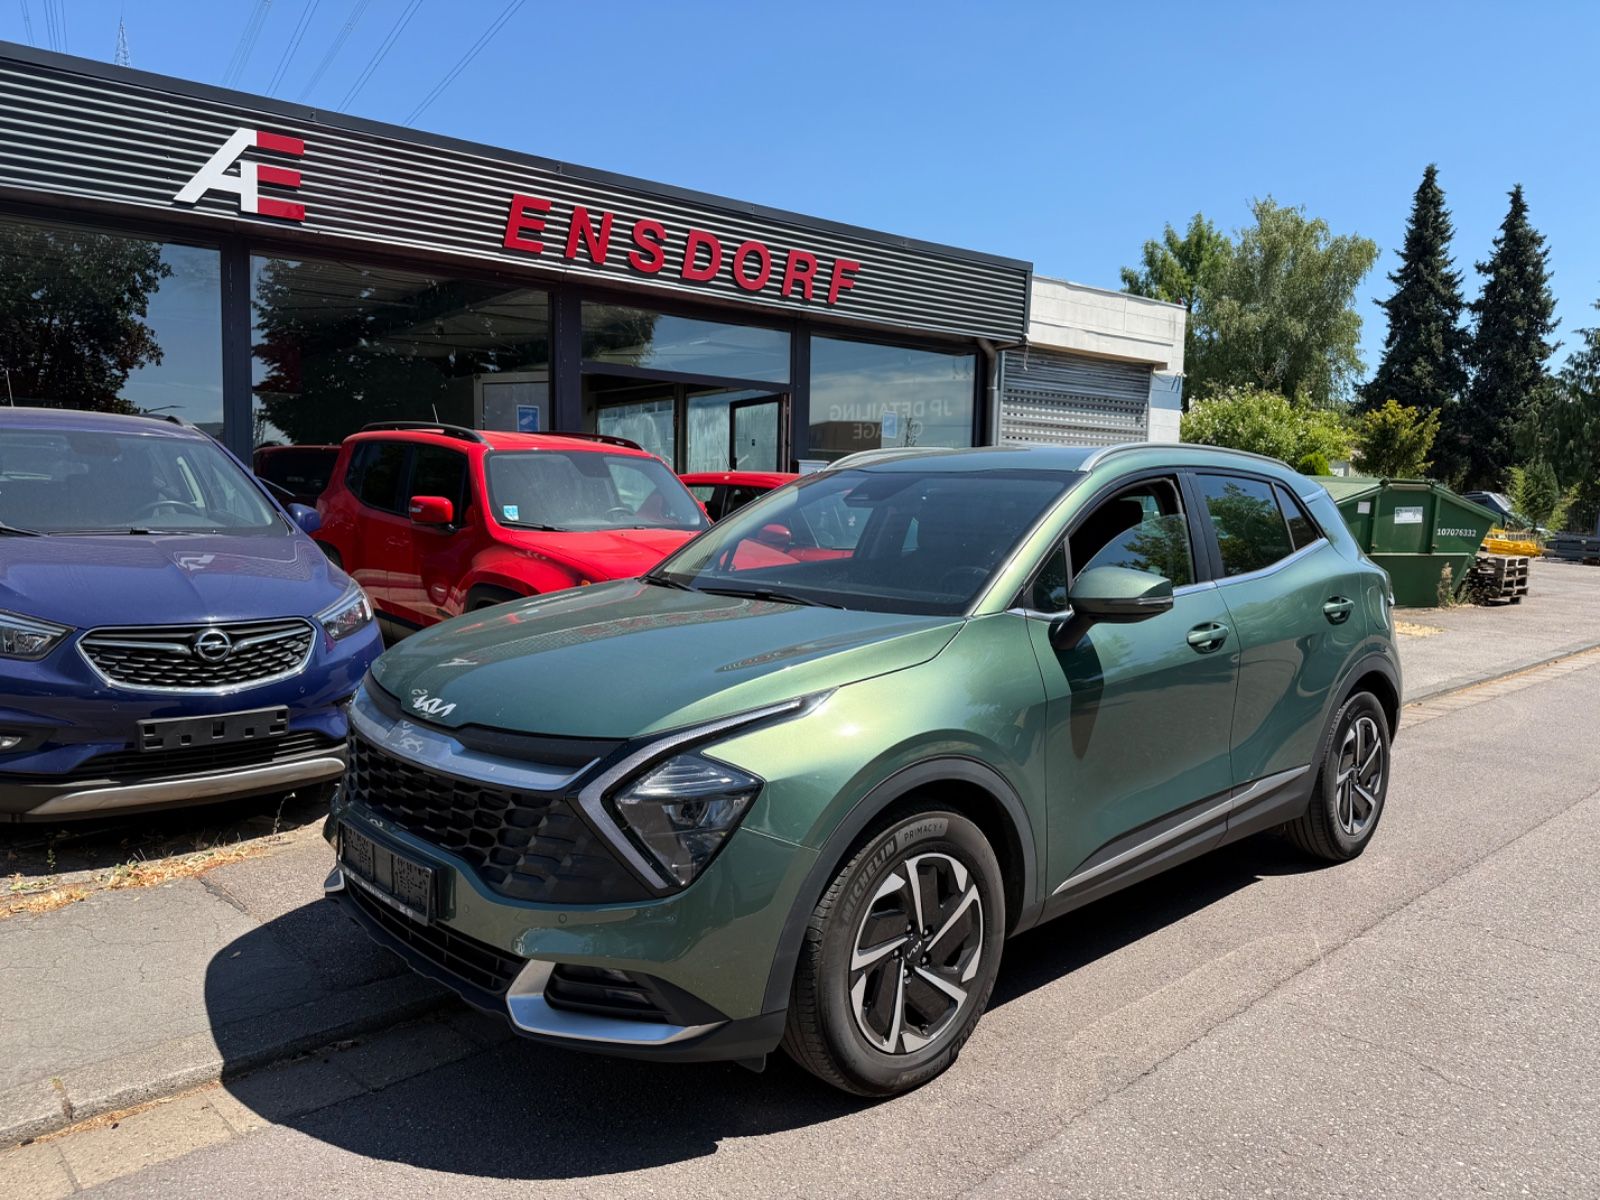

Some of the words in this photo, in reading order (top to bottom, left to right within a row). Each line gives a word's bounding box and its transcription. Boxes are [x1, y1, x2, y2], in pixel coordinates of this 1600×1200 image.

[503, 193, 860, 304] ENSDORF
[412, 694, 457, 718] KIA
[842, 839, 896, 924] MICHELIN
[904, 823, 938, 841] PRIMACY
